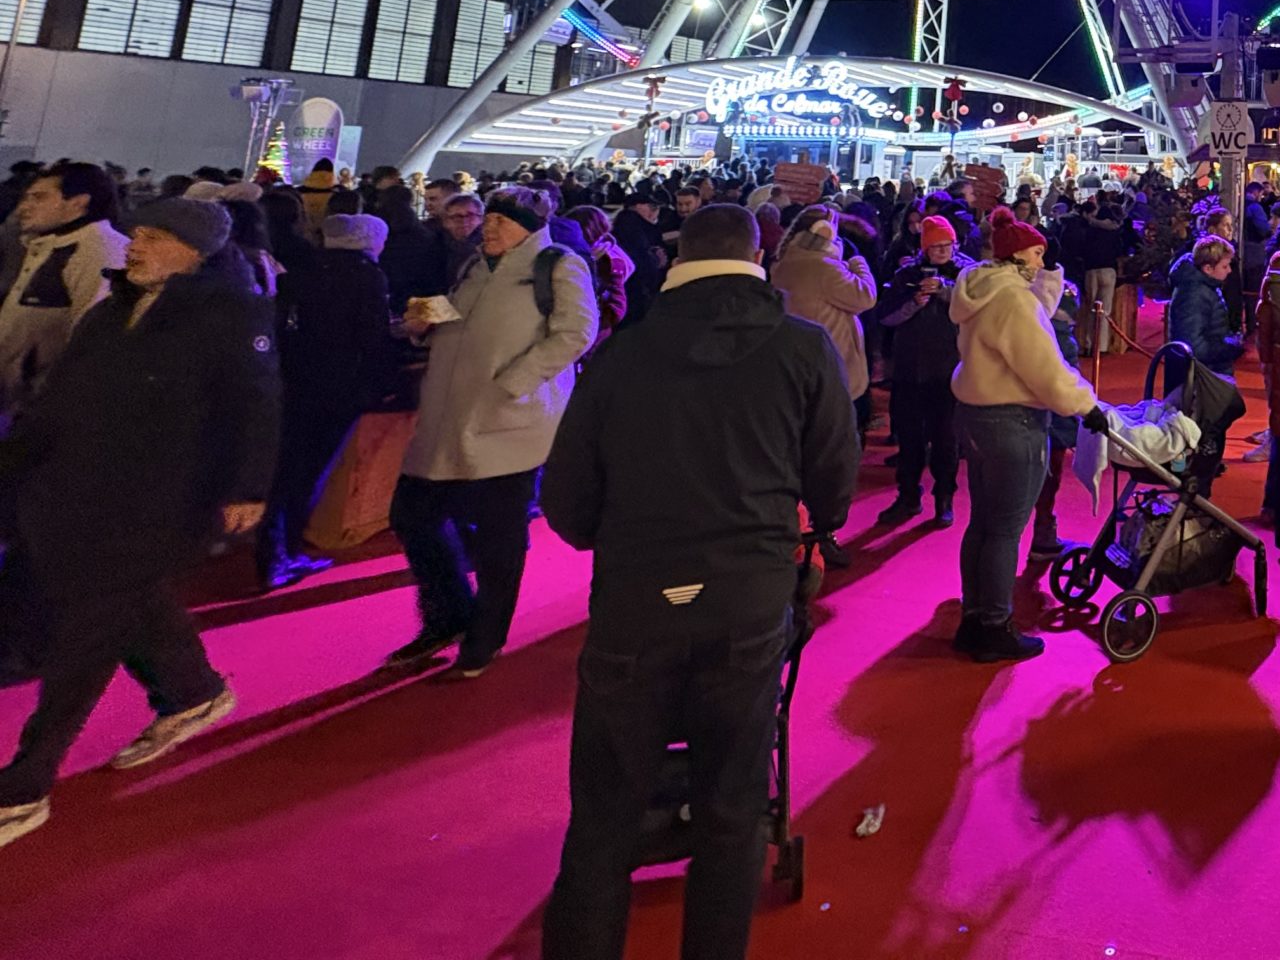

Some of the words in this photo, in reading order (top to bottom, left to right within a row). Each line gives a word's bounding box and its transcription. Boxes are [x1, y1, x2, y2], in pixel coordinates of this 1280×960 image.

[706, 56, 810, 122] Grande
[744, 94, 768, 113] de
[772, 93, 842, 115] Colmar
[293, 127, 335, 138] GREEN
[1211, 132, 1246, 150] WC
[293, 139, 332, 150] WHEEL
